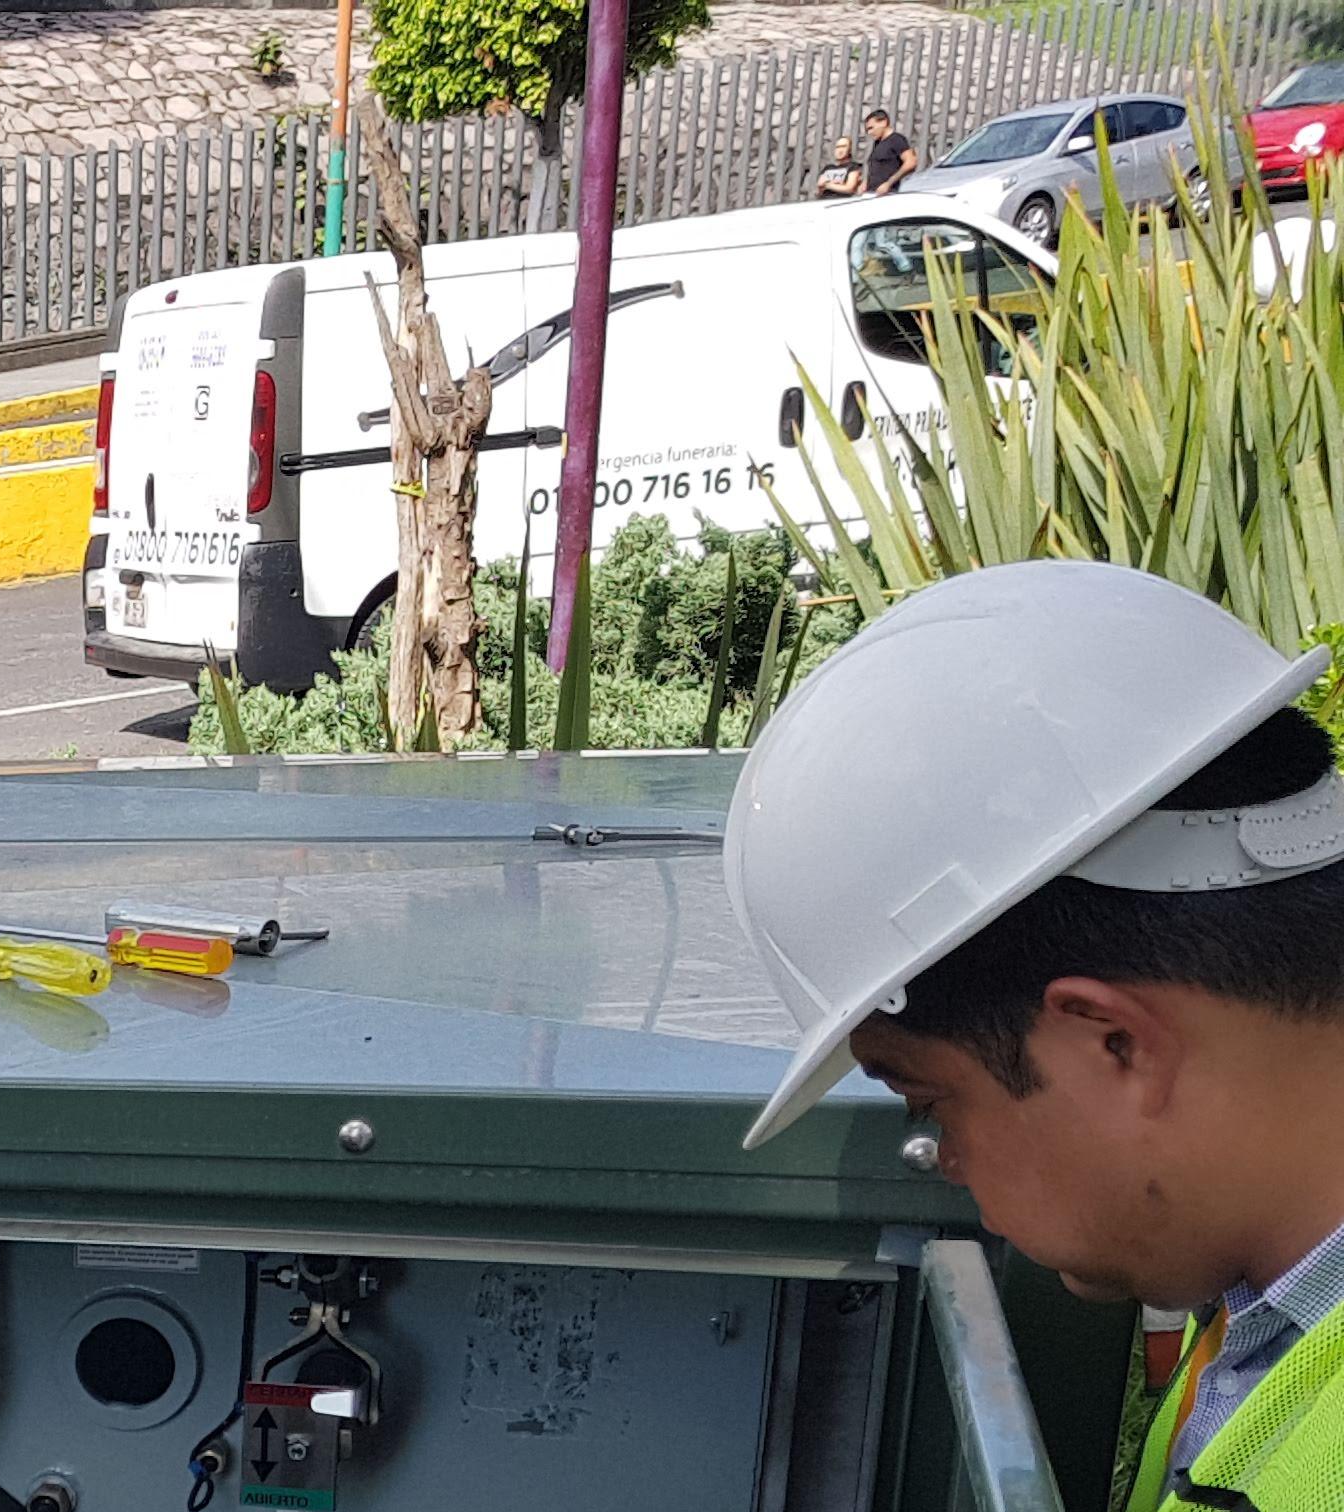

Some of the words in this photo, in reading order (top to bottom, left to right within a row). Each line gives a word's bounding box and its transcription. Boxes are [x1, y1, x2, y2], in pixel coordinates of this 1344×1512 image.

[667, 441, 737, 464] funeraria:
[642, 471, 691, 503] 716
[702, 467, 732, 494] 16
[170, 531, 241, 565] 7161616
[244, 1493, 309, 1507] ABIERTO
